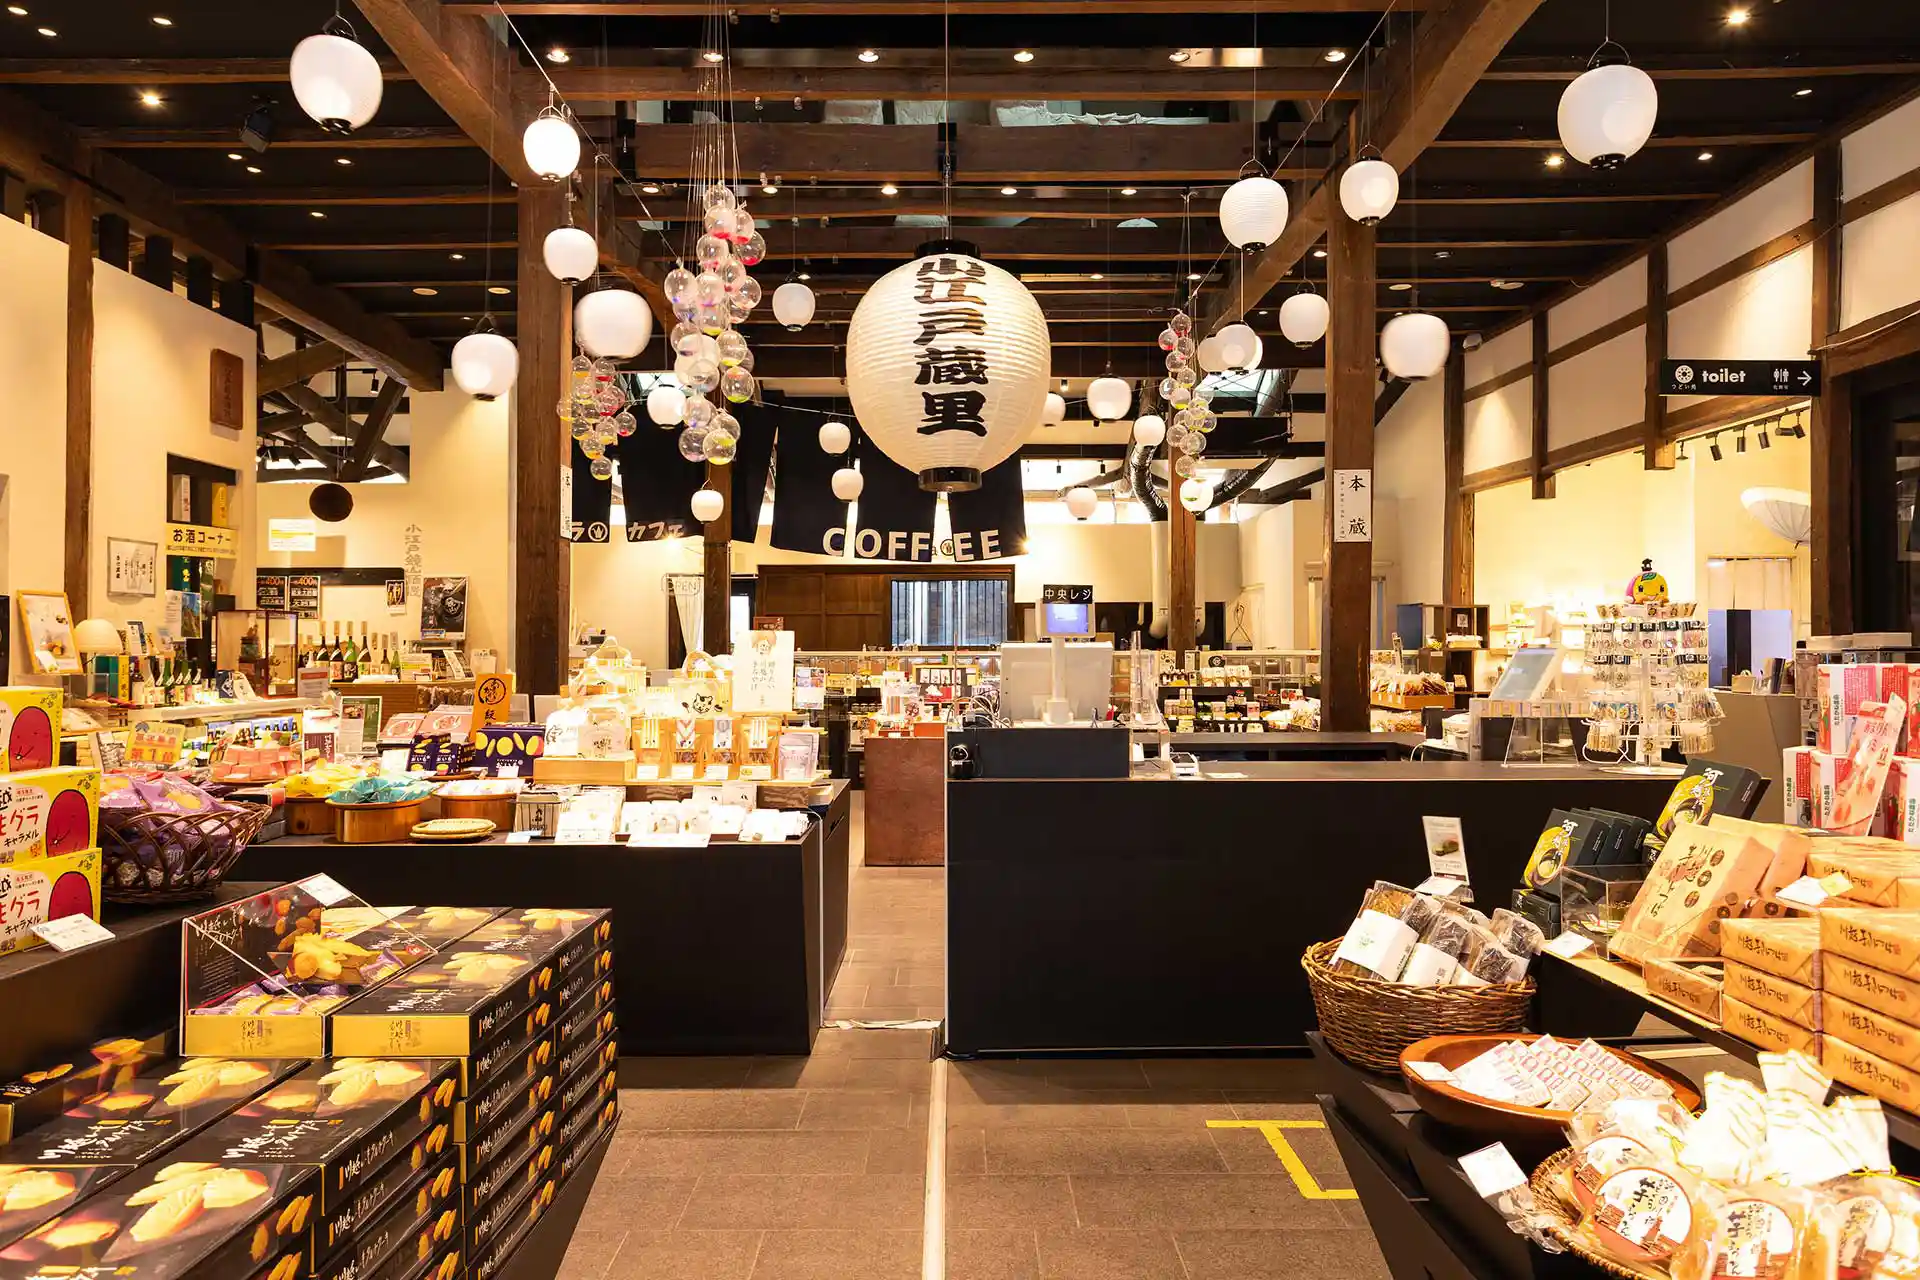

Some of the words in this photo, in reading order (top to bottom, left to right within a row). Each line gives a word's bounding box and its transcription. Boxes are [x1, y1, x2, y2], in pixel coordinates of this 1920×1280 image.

[913, 258, 989, 437] 小江戸蔵里
[1702, 368, 1746, 383] toilet
[1348, 474, 1367, 536] 本蔵
[172, 528, 231, 545] お酒コーナー
[628, 522, 684, 540] カフェ
[822, 527, 1002, 562] COFFEE
[1044, 588, 1091, 600] 中央レジ
[4, 828, 40, 847] キャラメル
[4, 915, 41, 936] キャラメル
